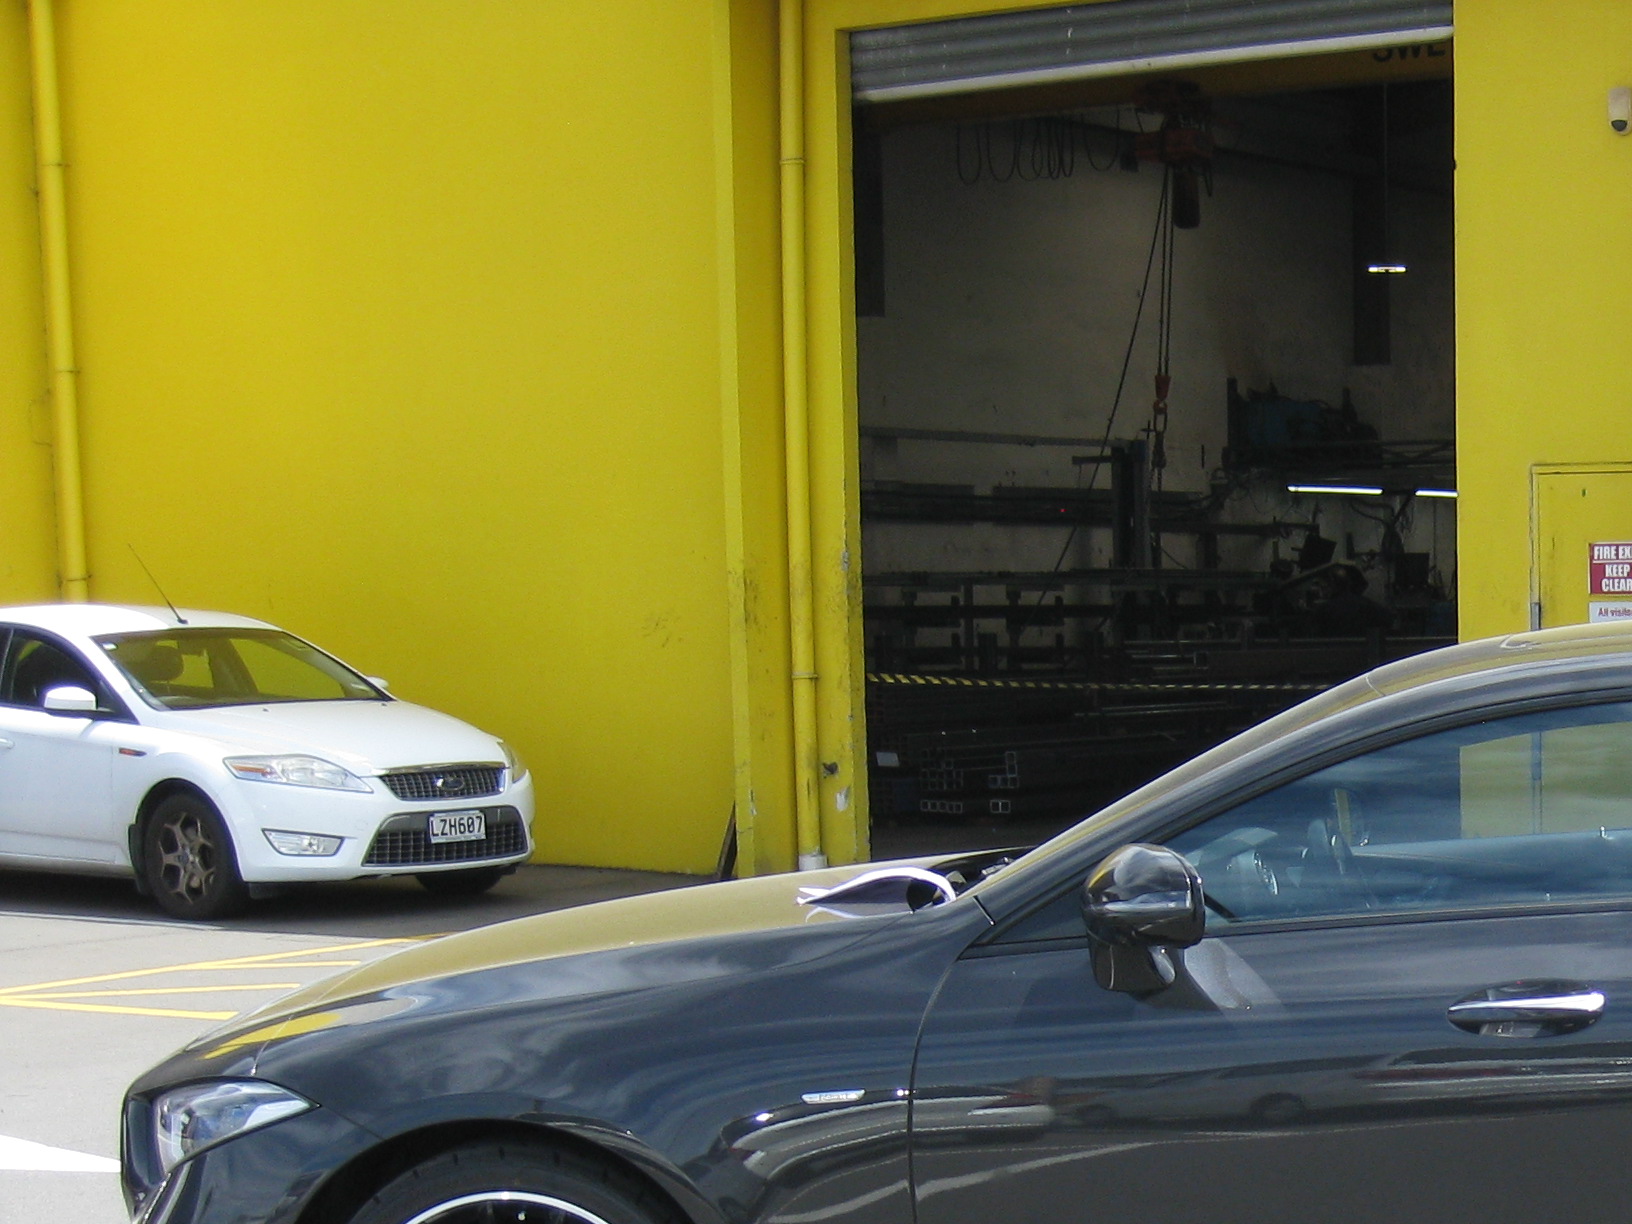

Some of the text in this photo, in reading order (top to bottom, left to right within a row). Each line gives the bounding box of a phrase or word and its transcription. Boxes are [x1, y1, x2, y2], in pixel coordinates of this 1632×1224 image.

[1594, 546, 1617, 559] FIRE
[1605, 564, 1631, 577] KEEP
[1598, 607, 1609, 617] All
[431, 816, 483, 837] LZH607
